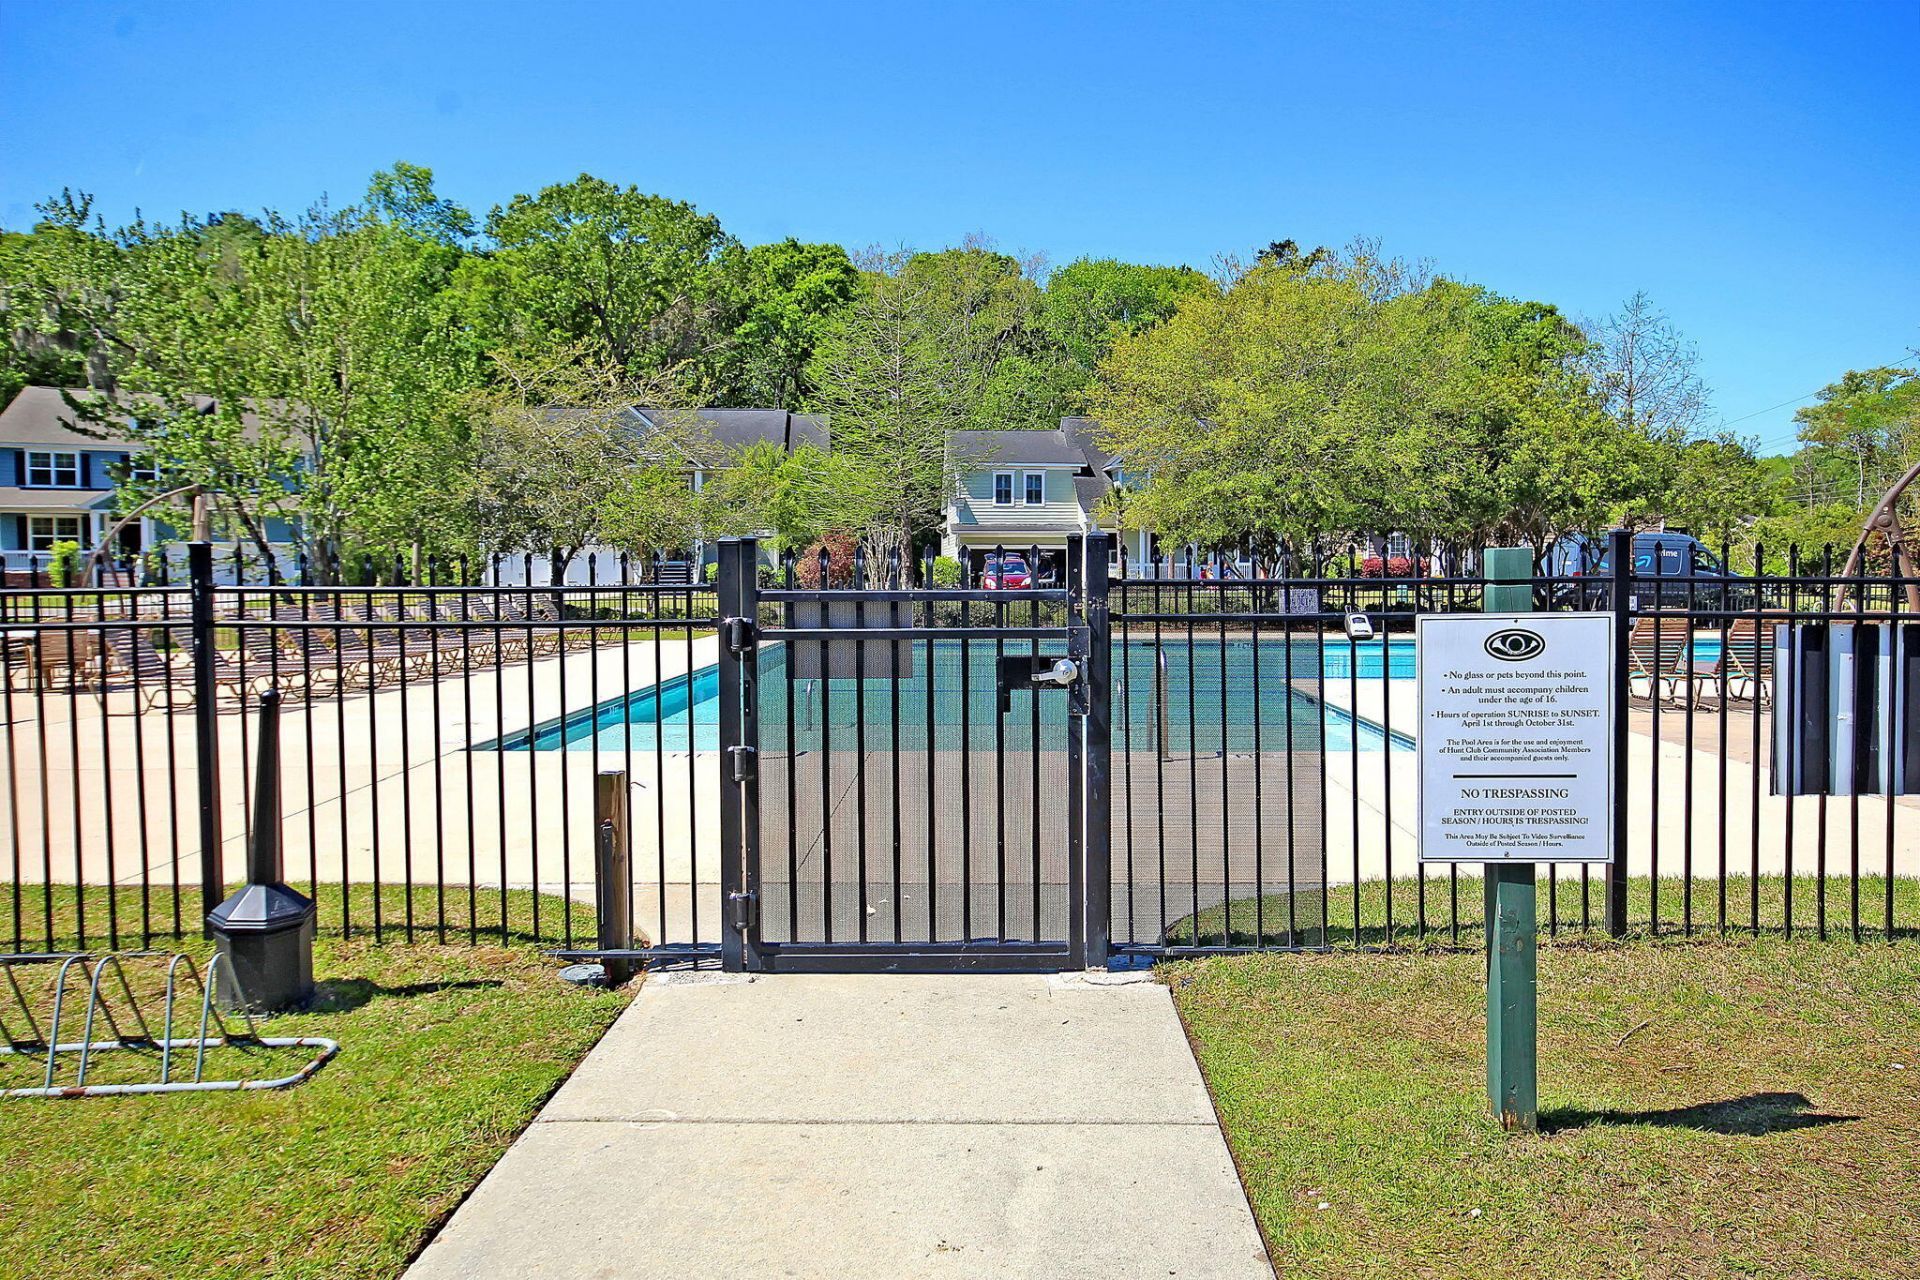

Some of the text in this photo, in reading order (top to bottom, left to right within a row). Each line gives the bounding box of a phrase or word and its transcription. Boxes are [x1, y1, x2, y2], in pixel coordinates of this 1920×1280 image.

[1449, 670, 1587, 680] No glass or pets beyond this point.
[1448, 685, 1589, 696] An adult must accompany children
[1478, 694, 1558, 704] under the age of 16.
[1436, 710, 1460, 718] Hours
[1461, 710, 1469, 718] of
[1471, 711, 1506, 719] operation
[1507, 710, 1550, 718] SUNRISE
[1461, 718, 1575, 728] April 1st through October 31st.
[1511, 738, 1522, 746] the
[1549, 739, 1583, 747] enjoyment
[1482, 746, 1521, 755] Community
[1522, 746, 1560, 754] Association
[1490, 754, 1532, 763] accompanied
[1532, 755, 1553, 763] guests
[1461, 789, 1569, 798] NO TRESPASSING
[1453, 808, 1577, 816] ENTRY OUTSIDE OF POSTED
[1514, 816, 1524, 824] IS
[1475, 834, 1489, 842] May
[1498, 833, 1521, 841] Subject
